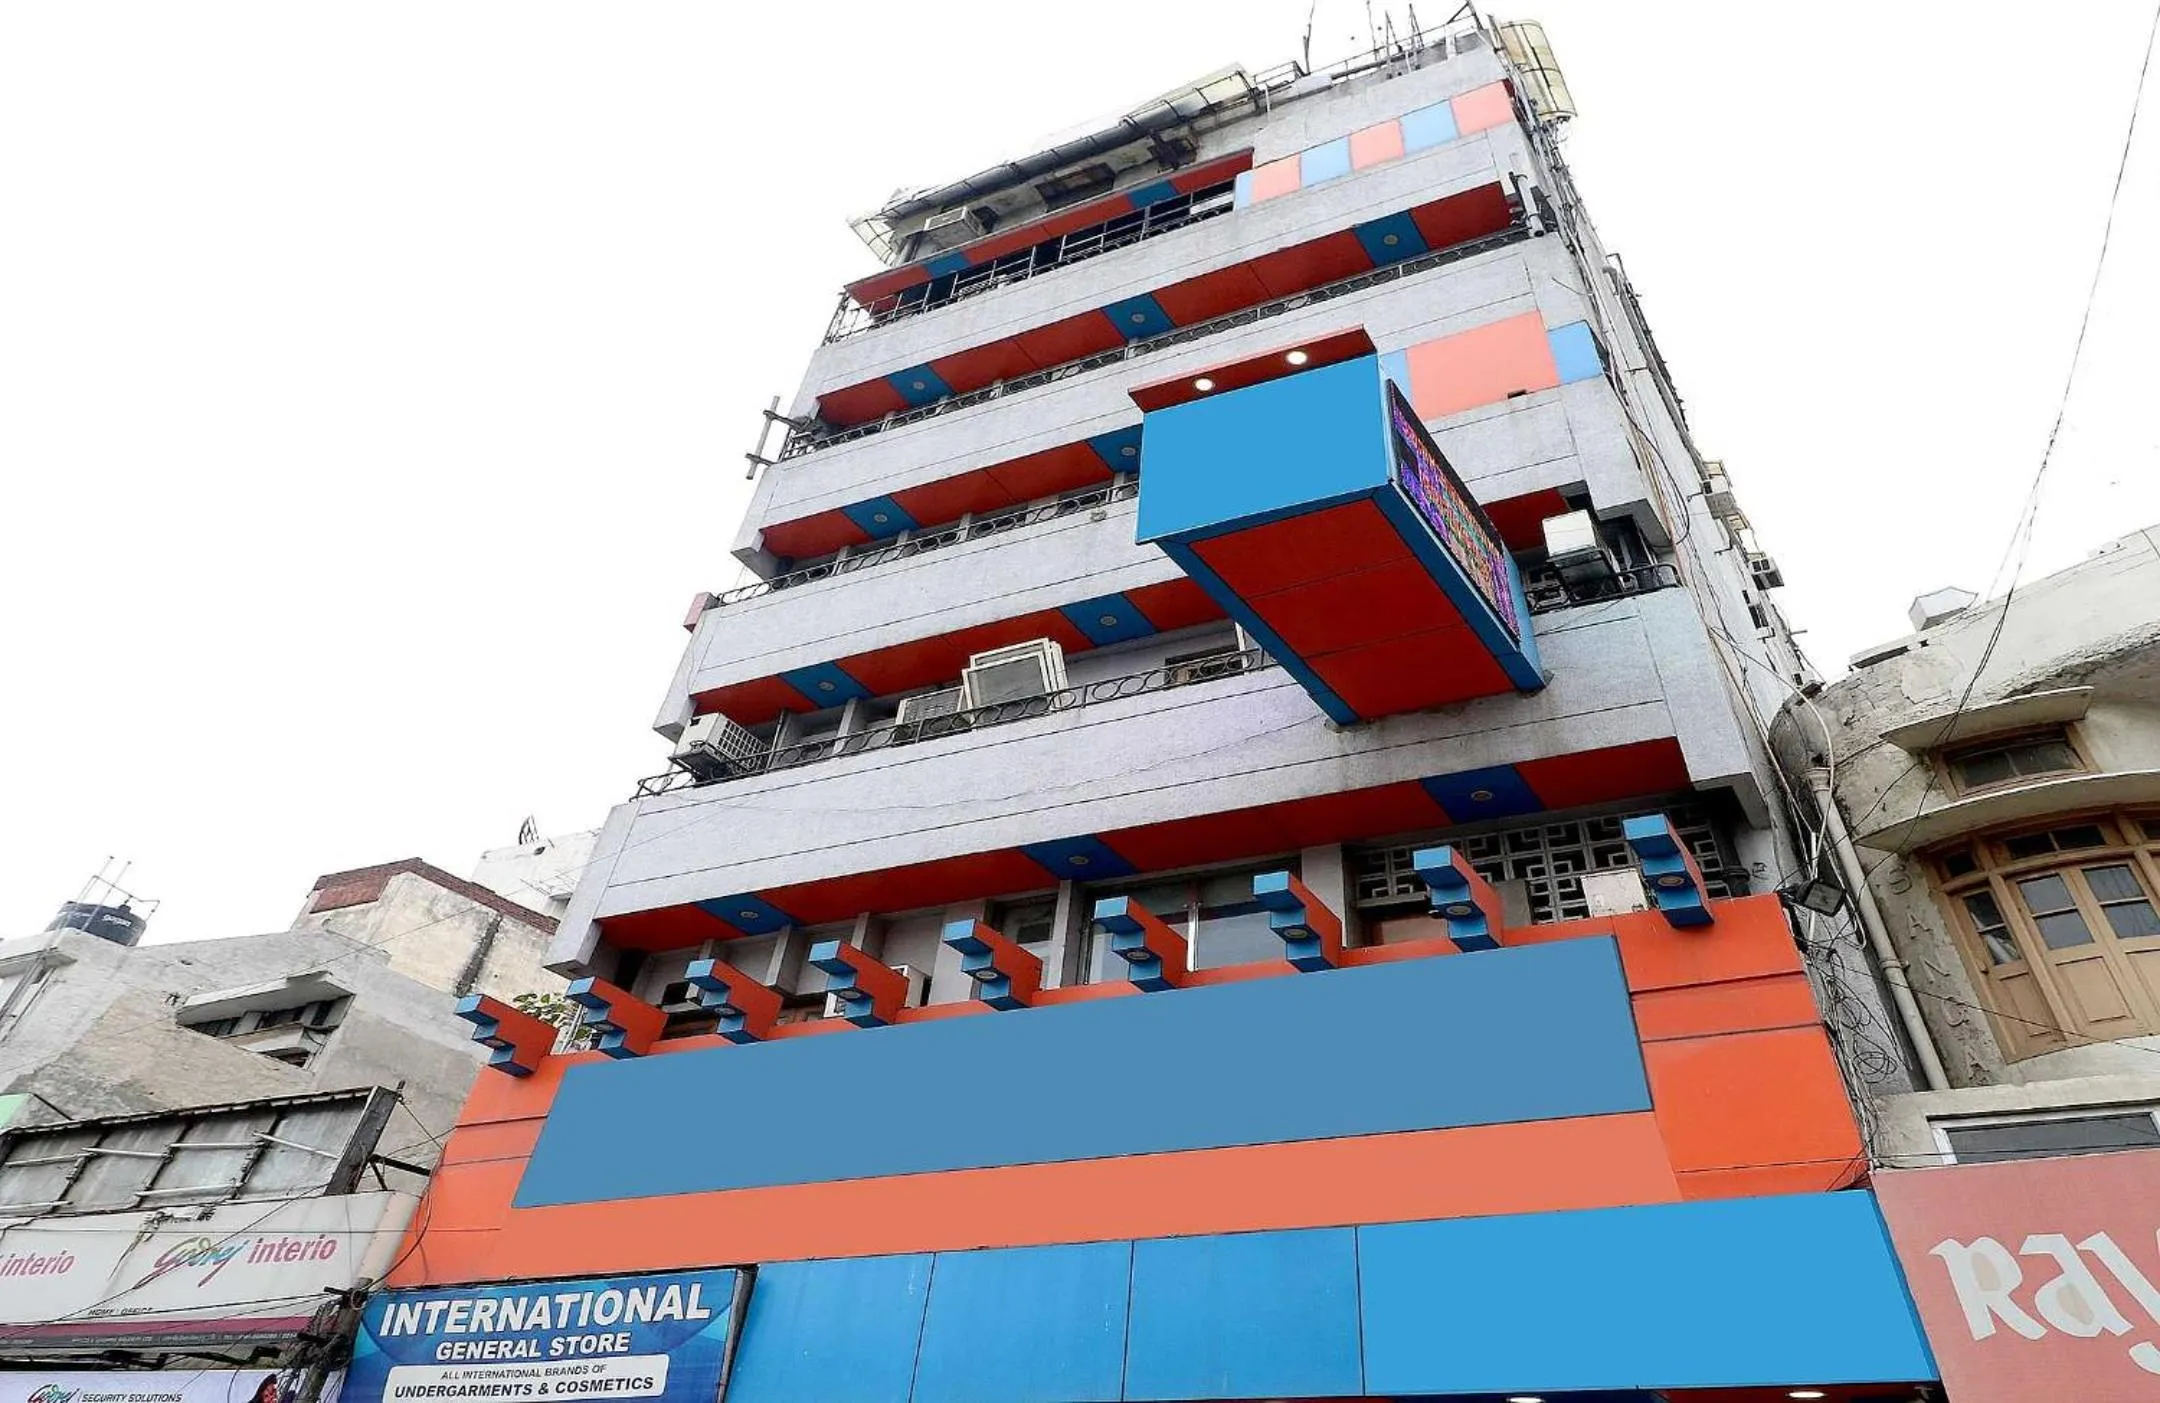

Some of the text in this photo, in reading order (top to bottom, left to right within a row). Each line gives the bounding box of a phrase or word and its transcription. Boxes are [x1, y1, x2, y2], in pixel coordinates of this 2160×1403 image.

[248, 1234, 337, 1264] interio
[0, 1250, 75, 1276] interio
[379, 1283, 711, 1336] INTERNATIONAL
[435, 1332, 632, 1361] GENERAL STORE
[441, 1363, 607, 1380] ALL INTERNATIONAL BRANDS OF
[82, 1393, 127, 1403] SECURITY
[131, 1392, 183, 1403] SOLUTIONS
[394, 1376, 655, 1398] UNDERGARMENTS & COSMETICS
